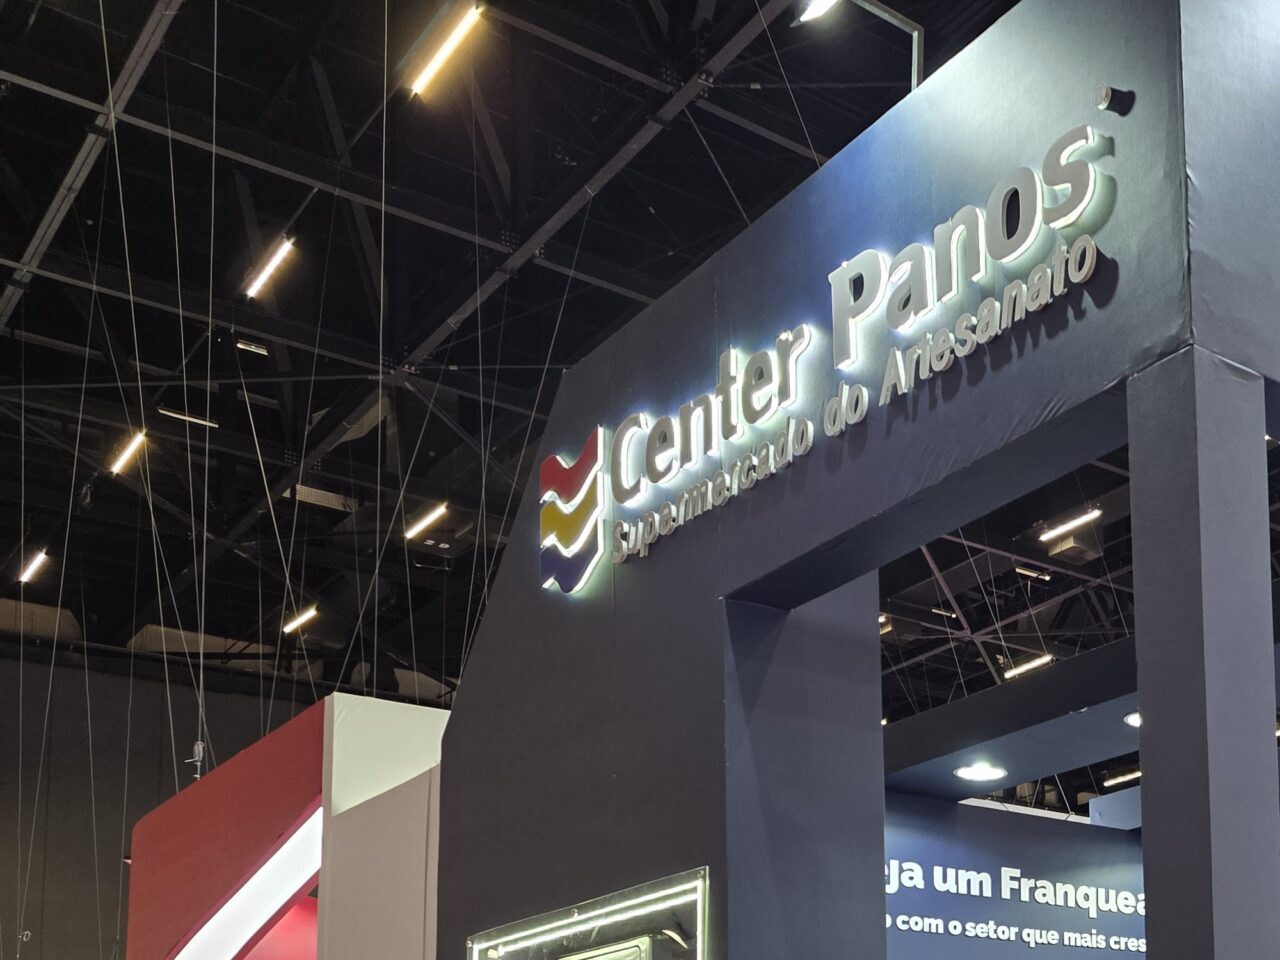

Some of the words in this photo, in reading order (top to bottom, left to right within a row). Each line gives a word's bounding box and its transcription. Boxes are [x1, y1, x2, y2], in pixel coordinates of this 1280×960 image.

[611, 322, 812, 506] Center
[829, 125, 1097, 370] Panos
[612, 418, 813, 563] Supermercado
[823, 380, 869, 436] do
[879, 235, 1098, 407] Artesanato
[896, 914, 944, 934] com
[948, 919, 962, 935] o
[965, 920, 1019, 941] setor
[1021, 928, 1060, 947] que
[1063, 929, 1106, 949] mais
[933, 865, 992, 898] um
